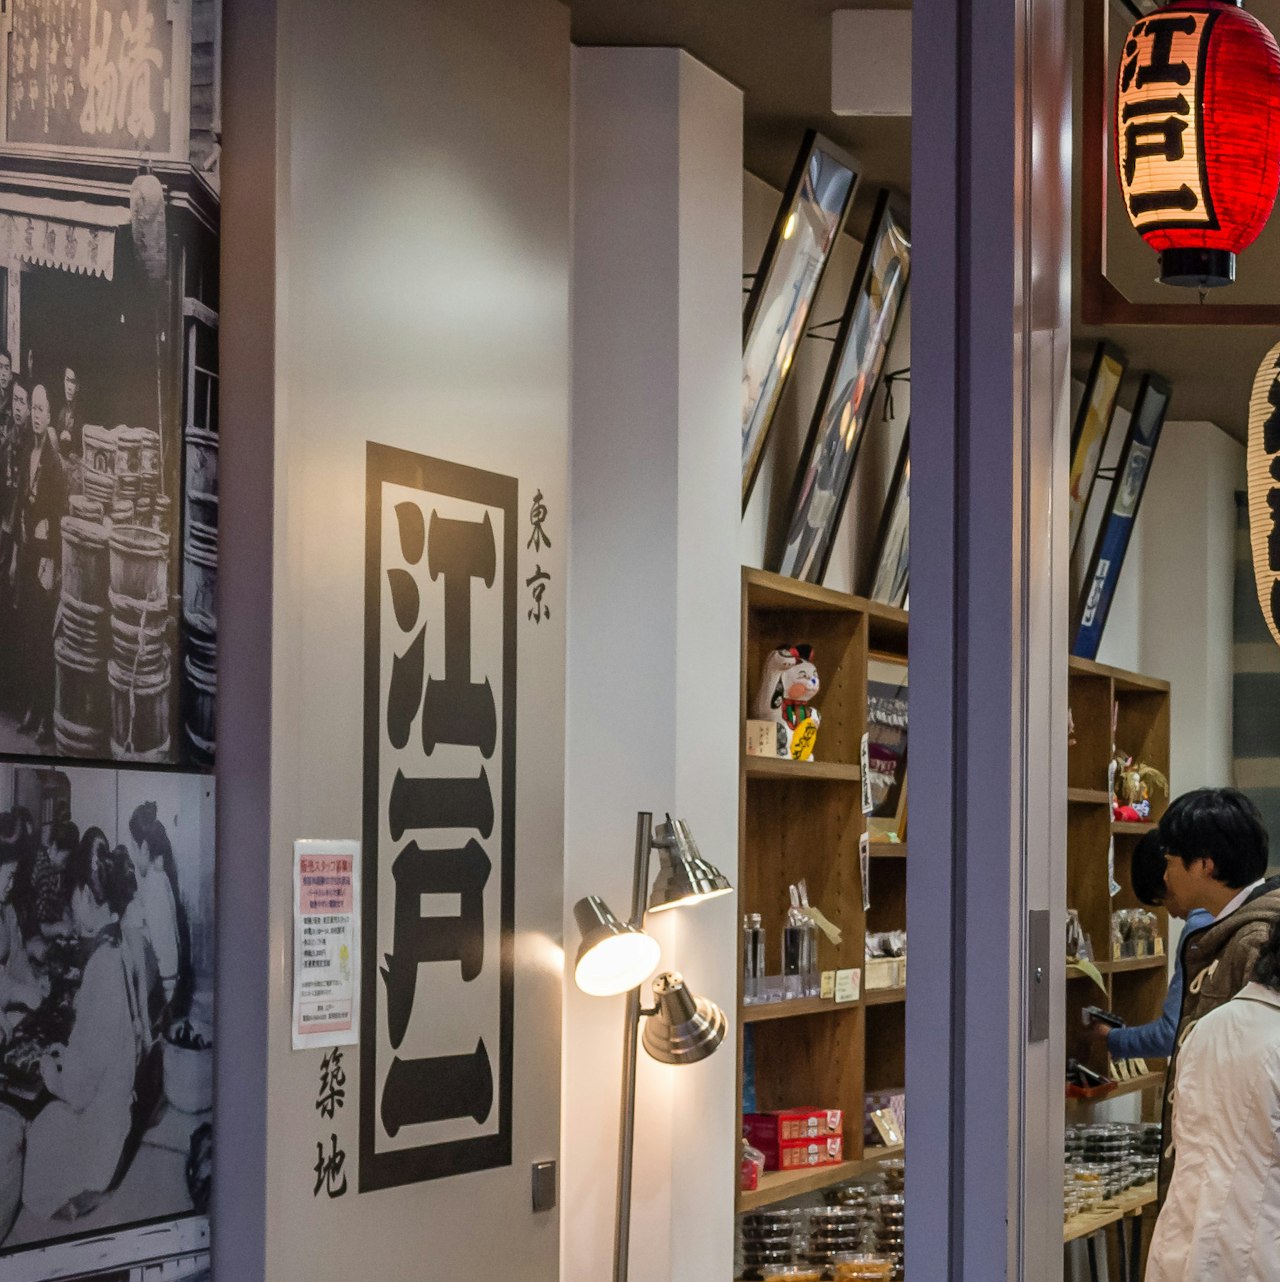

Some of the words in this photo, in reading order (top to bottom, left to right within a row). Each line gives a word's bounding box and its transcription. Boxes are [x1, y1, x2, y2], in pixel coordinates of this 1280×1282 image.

[1122, 14, 1199, 218] 江戸一
[526, 488, 553, 627] 東京
[379, 499, 499, 1140] 江戸一
[312, 1046, 350, 1201] 築地
